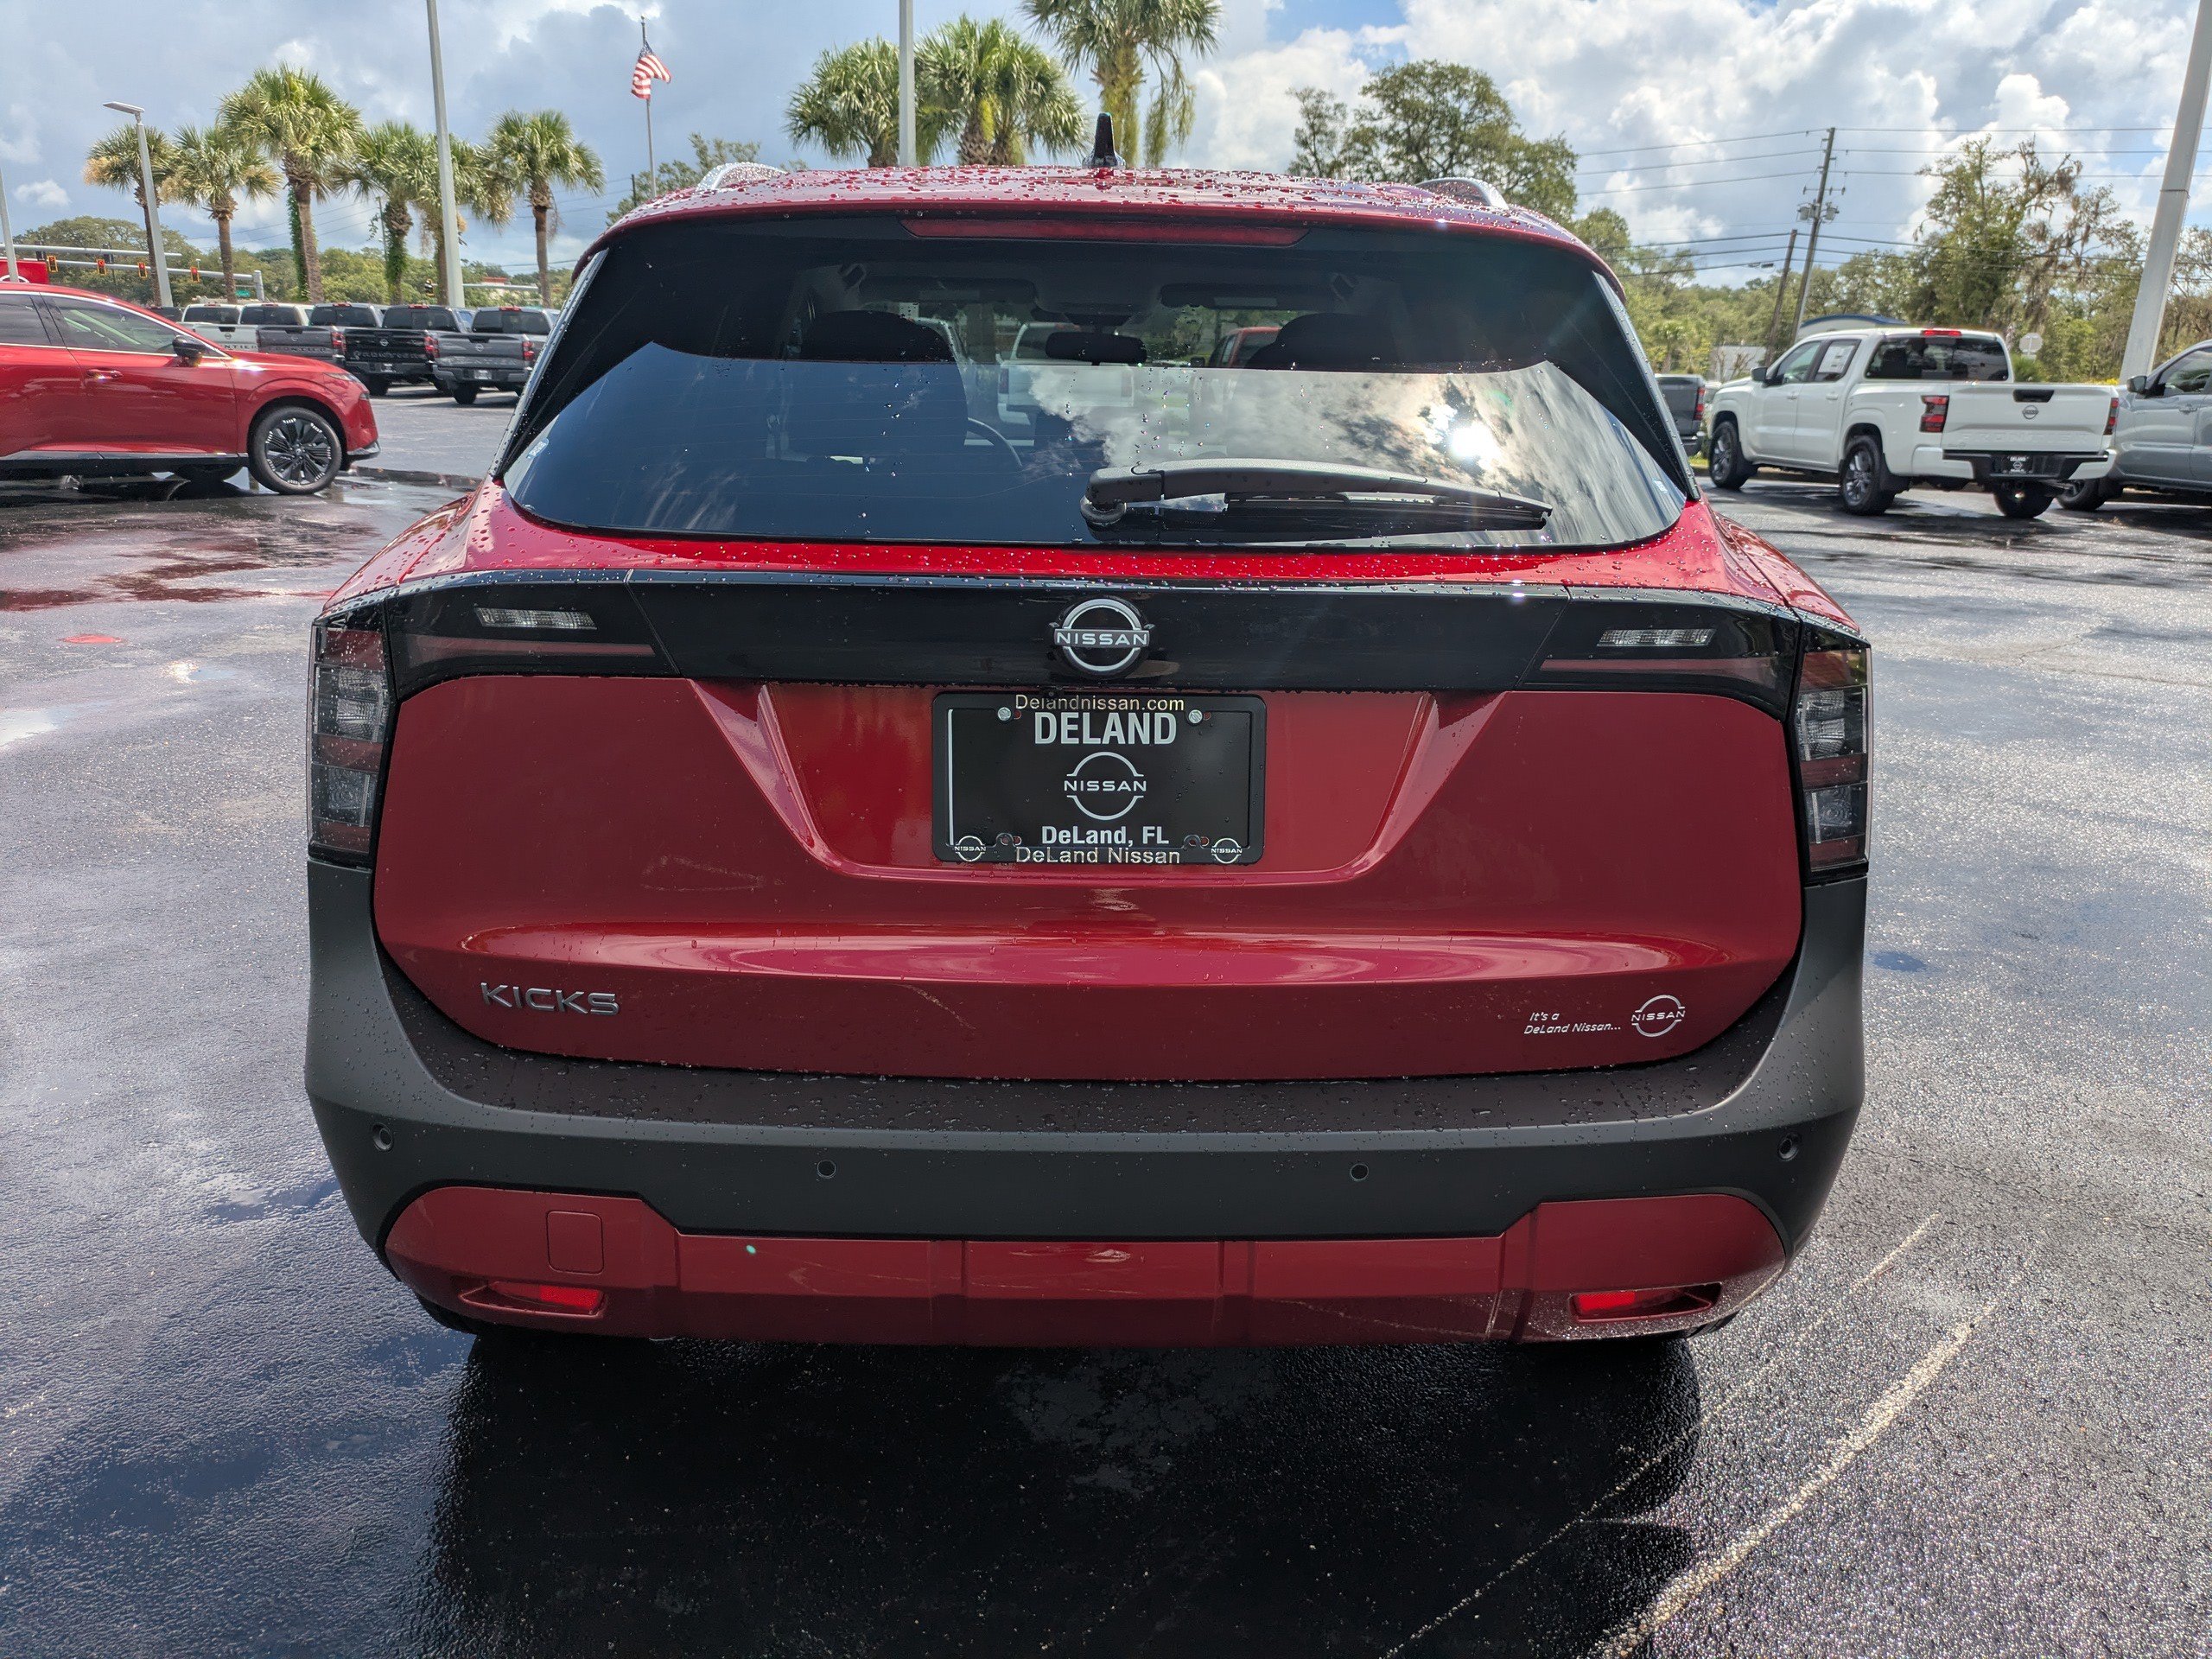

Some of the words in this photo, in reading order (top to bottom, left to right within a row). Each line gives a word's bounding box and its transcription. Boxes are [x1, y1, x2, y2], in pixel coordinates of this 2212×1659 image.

[1056, 632, 1147, 645] NISSAN
[1014, 694, 1185, 710] Delandnissan.com
[1035, 711, 1177, 745] DELAND
[1064, 779, 1147, 792] NISSAN
[1041, 825, 1134, 847] DeLand,
[1142, 826, 1170, 845] FL
[1015, 846, 1098, 863] DeLand
[1108, 847, 1180, 864] Nissan
[480, 982, 620, 1016] KICKS
[1529, 1012, 1549, 1021] It's
[1551, 1012, 1560, 1021] a
[1630, 1009, 1686, 1022] NISSAN
[1523, 1024, 1570, 1035] DeLand
[1571, 1022, 1622, 1033] Nissan...
